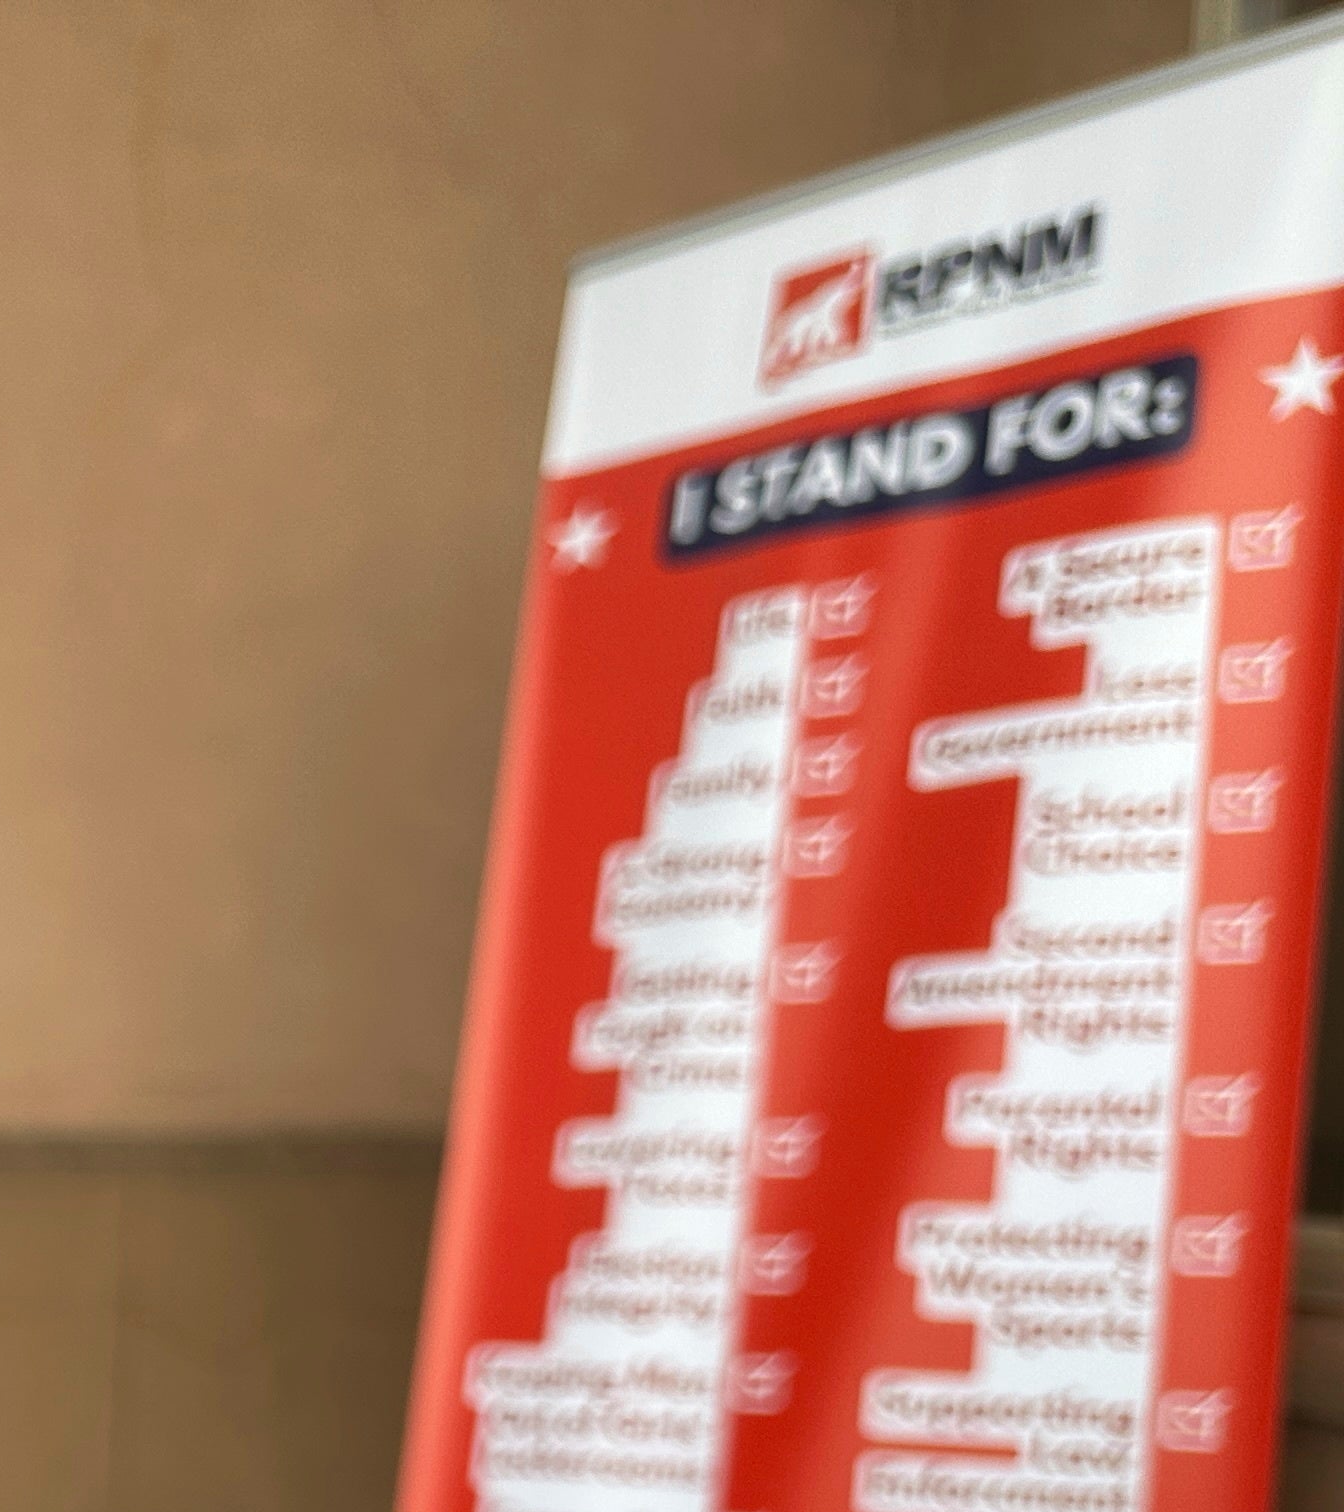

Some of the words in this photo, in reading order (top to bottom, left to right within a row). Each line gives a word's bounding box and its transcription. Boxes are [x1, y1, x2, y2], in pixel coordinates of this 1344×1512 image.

[875, 206, 1102, 322] RPNM
[670, 470, 708, 548] I
[711, 410, 978, 537] STAND
[985, 367, 1187, 476] FOR:
[1057, 533, 1206, 582] Secure
[1045, 579, 1205, 625] Border
[922, 706, 1194, 766] Government
[1032, 784, 1184, 831] School
[1026, 832, 1182, 876] Choice
[1011, 913, 1174, 958] Second
[899, 963, 1173, 1008] Amendment
[1020, 1006, 1171, 1054] Rights
[956, 1084, 1160, 1126] Parental
[1013, 1131, 1160, 1180] Rights
[912, 1214, 1149, 1264] Protecting
[927, 1260, 1150, 1308] Women's
[992, 1310, 1144, 1358] Sports
[870, 1385, 1136, 1436] Supporting
[1027, 1428, 1132, 1473] Law
